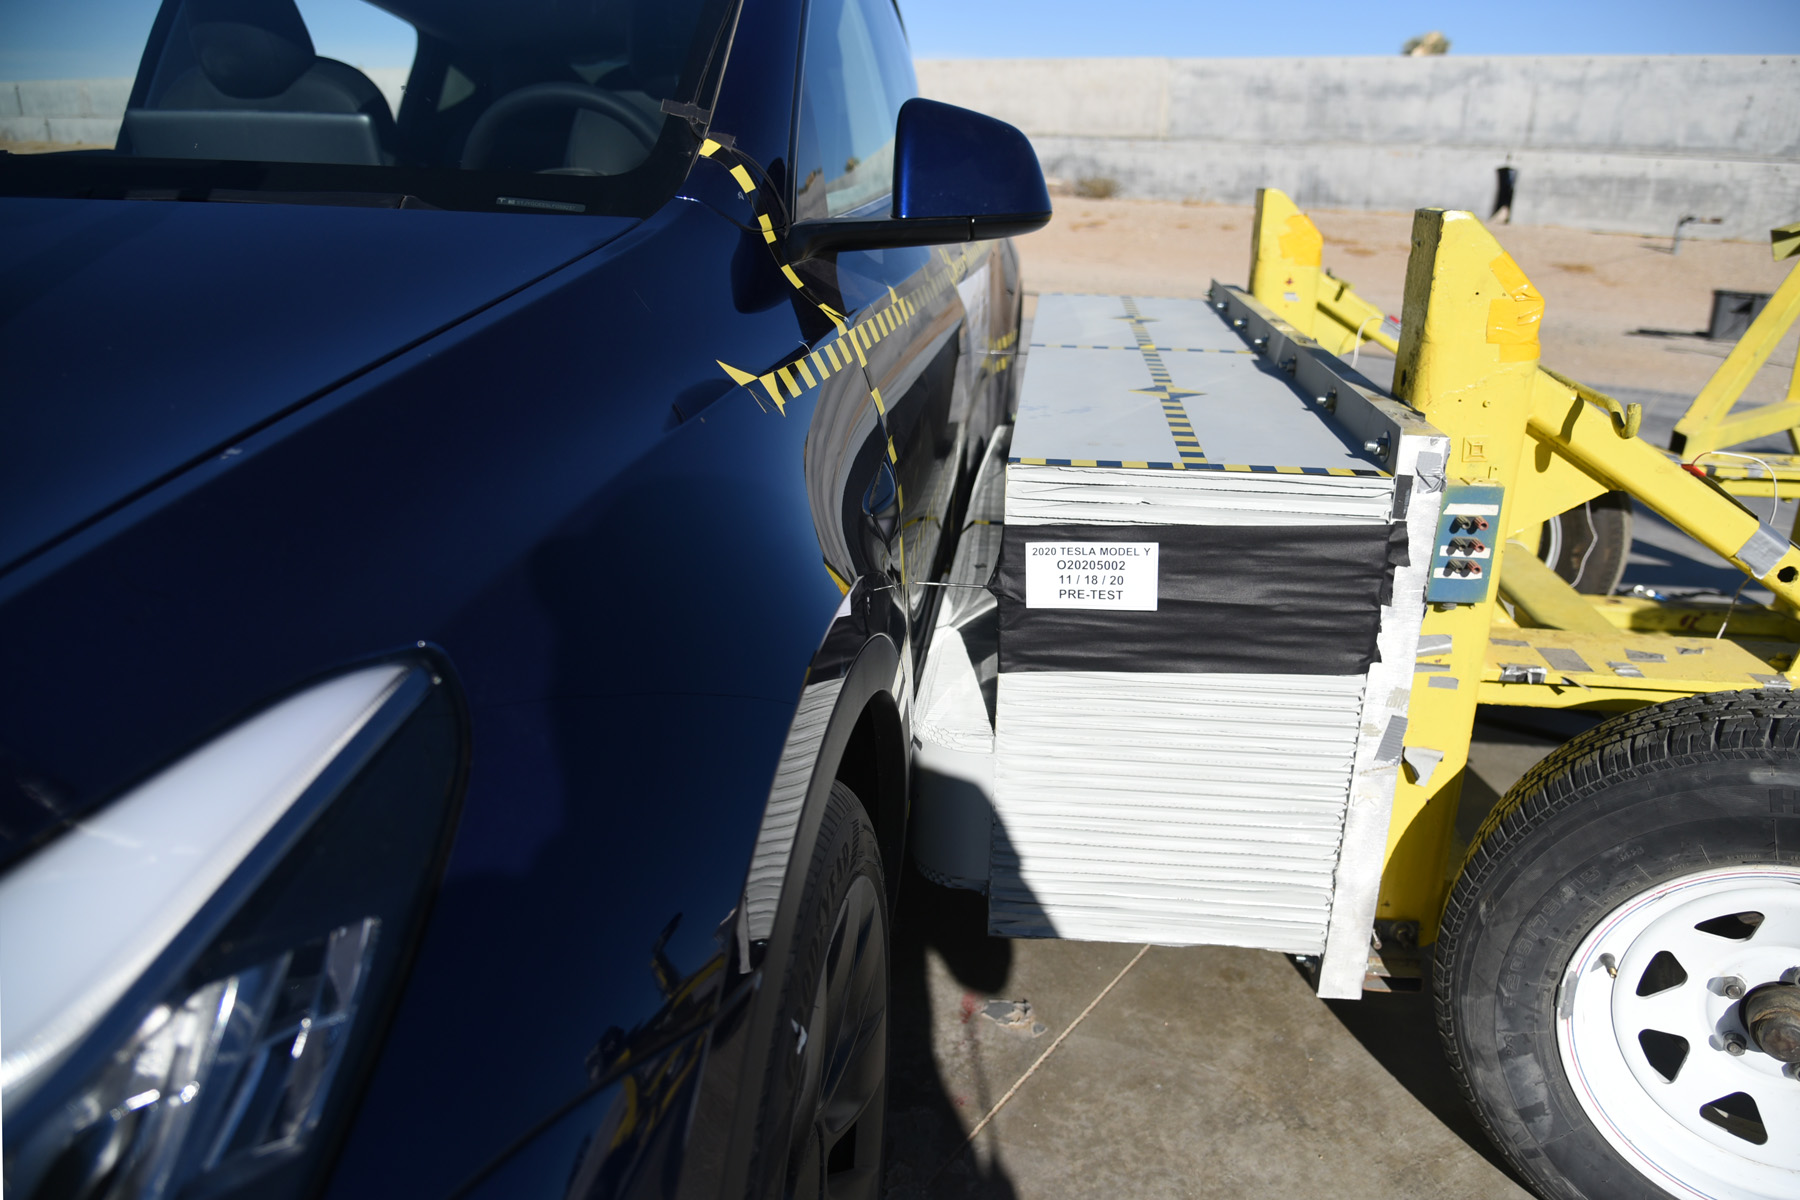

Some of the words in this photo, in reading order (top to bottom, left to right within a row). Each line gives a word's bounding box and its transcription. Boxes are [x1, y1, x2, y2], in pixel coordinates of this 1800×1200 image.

[1061, 547, 1096, 555] TESLA
[1100, 548, 1139, 556] MODEL
[1059, 575, 1071, 584] 11
[1085, 575, 1098, 584] 18
[1110, 576, 1124, 585] 20
[1060, 590, 1123, 600] PRE-TEST
